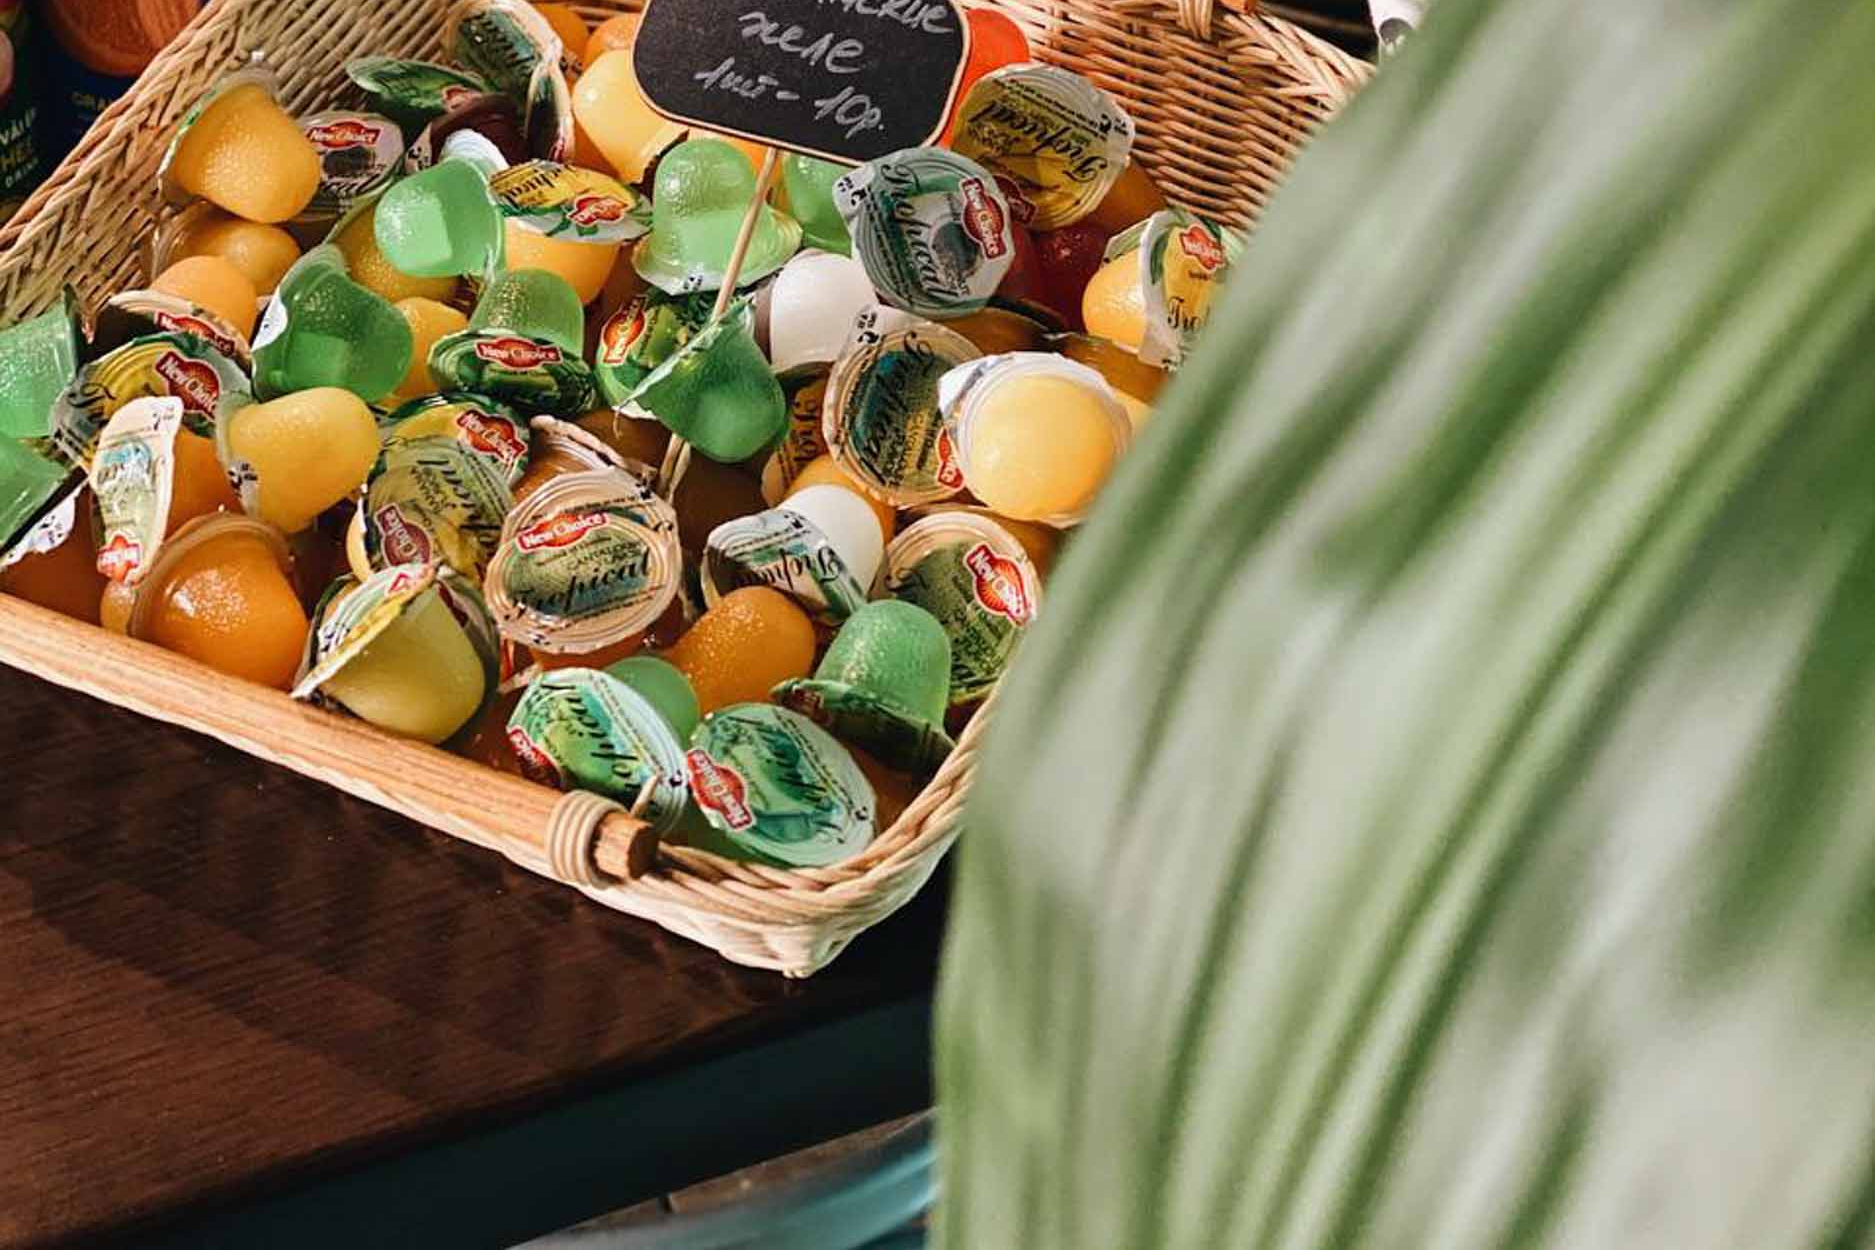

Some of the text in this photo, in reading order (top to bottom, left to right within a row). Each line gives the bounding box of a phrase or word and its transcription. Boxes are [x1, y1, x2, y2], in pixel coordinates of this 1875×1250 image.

[968, 99, 1108, 186] Tropical
[880, 162, 961, 298] Tropical
[965, 181, 1001, 256] New Choice
[161, 357, 187, 387] New
[386, 508, 415, 557] Choice
[522, 512, 602, 547] New Choice
[504, 546, 650, 620] Tropical
[970, 549, 999, 584] New
[542, 684, 640, 789] ropical
[690, 750, 729, 799] Choice
[720, 790, 747, 824] New
